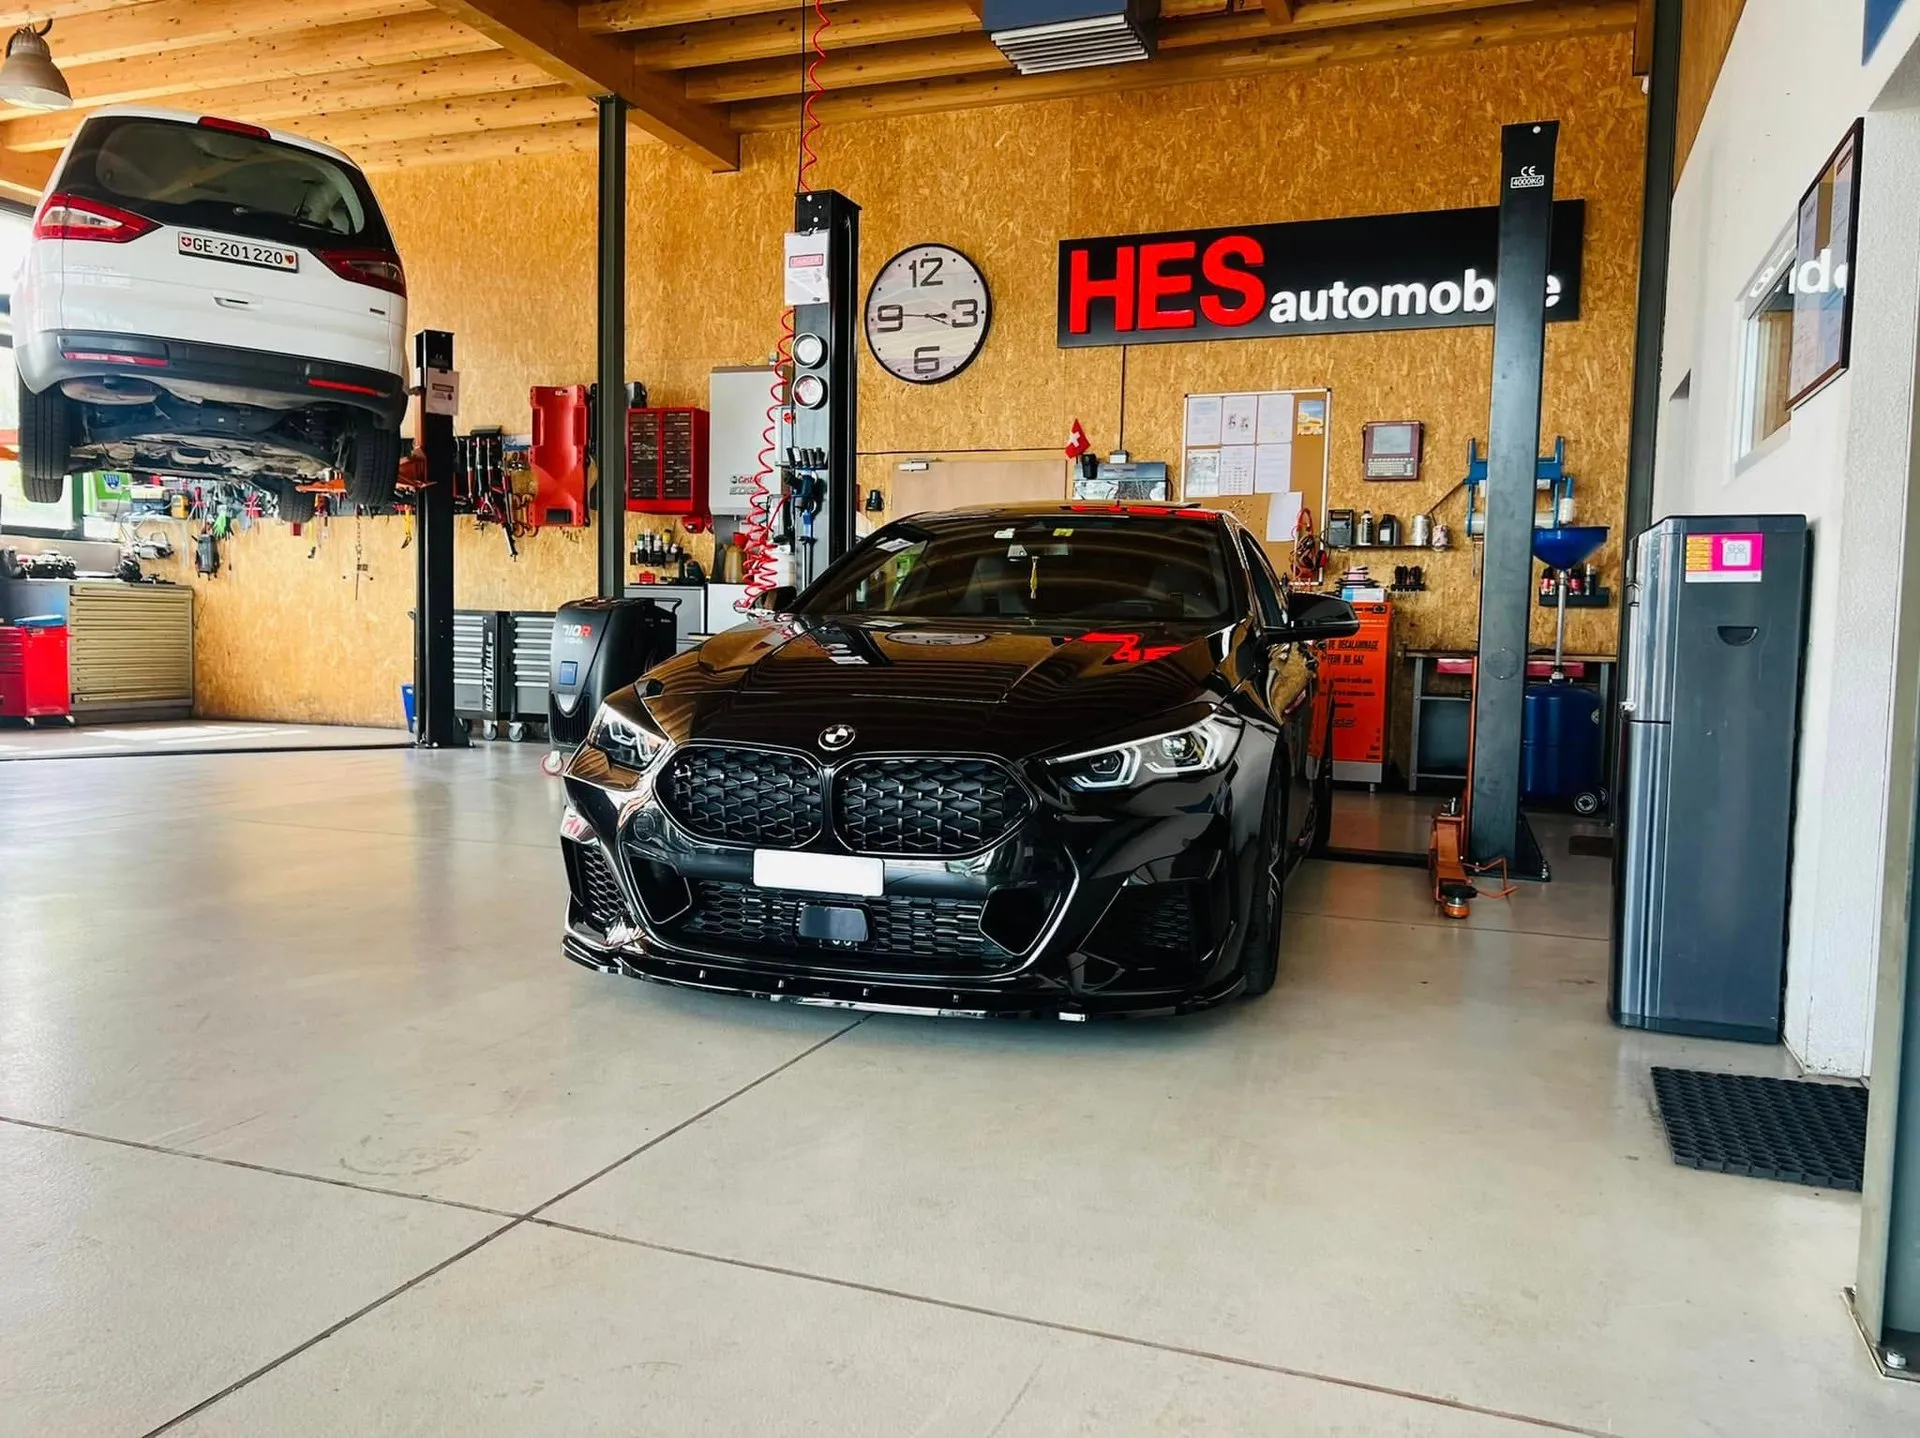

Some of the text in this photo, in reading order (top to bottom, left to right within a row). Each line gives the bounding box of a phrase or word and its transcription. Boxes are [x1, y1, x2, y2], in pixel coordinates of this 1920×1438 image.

[1520, 165, 1536, 177] CE
[909, 257, 944, 288] 12
[1069, 236, 1561, 334] HES automobe
[877, 304, 904, 333] 9
[952, 299, 978, 328] 3
[914, 346, 940, 374] 6
